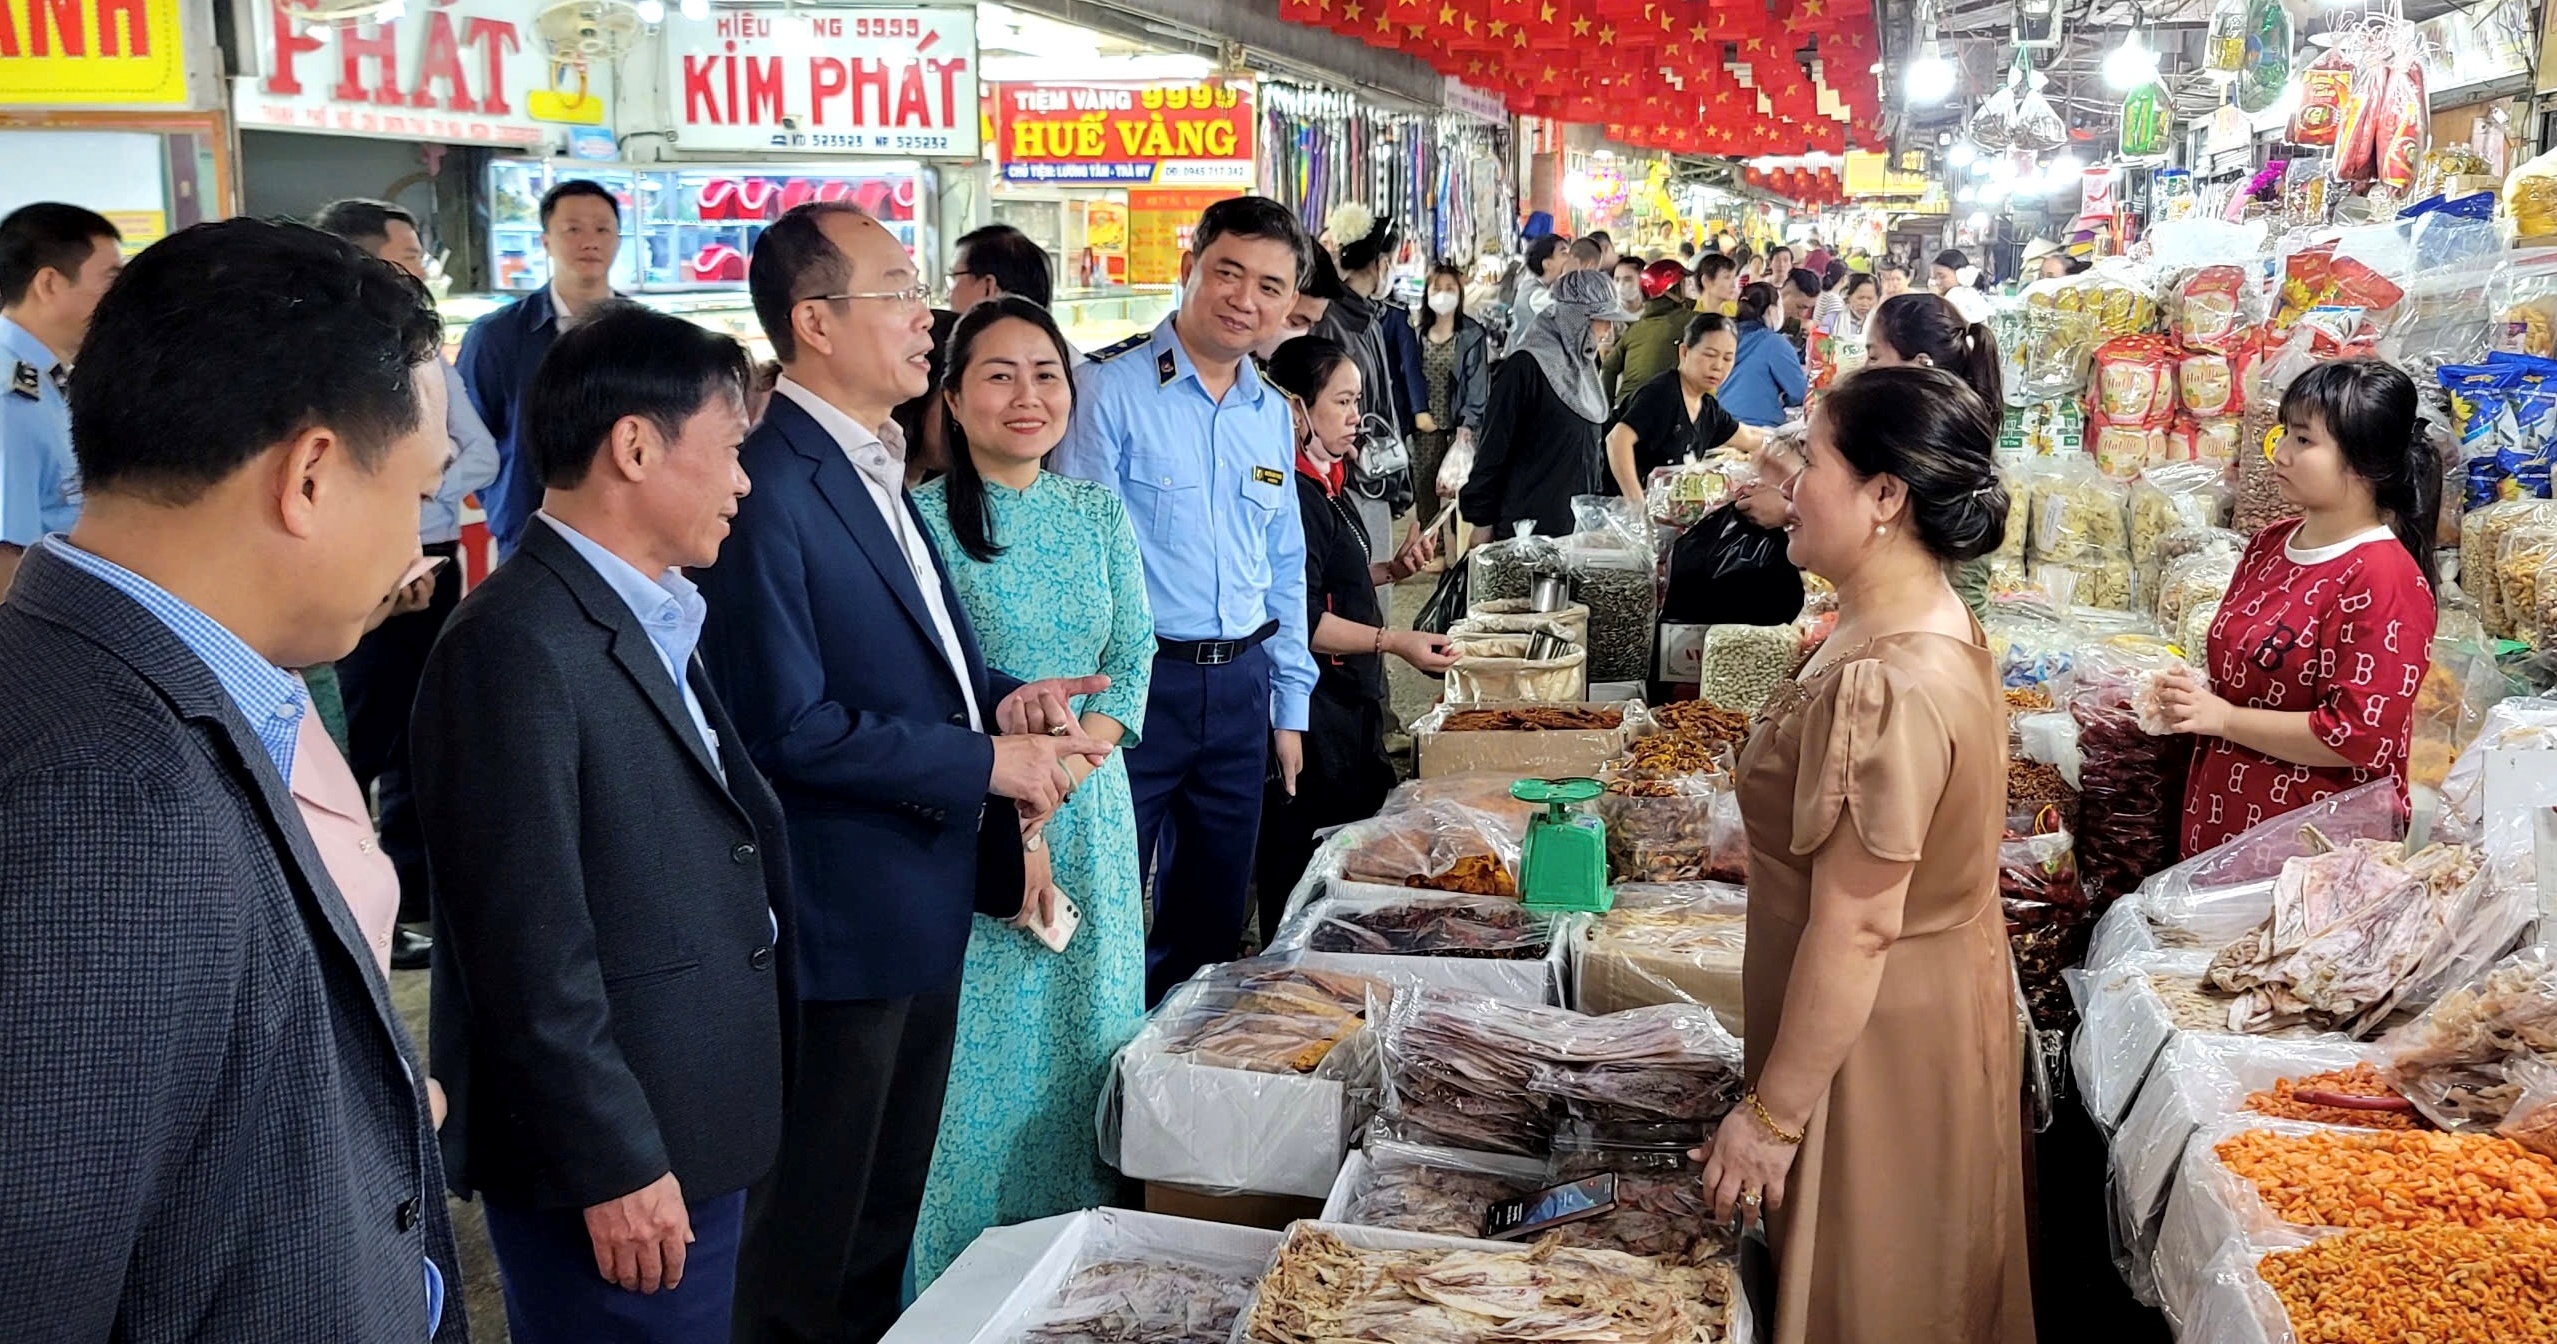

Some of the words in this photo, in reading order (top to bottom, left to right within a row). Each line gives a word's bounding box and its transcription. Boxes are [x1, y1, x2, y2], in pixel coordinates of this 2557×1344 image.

[856, 17, 920, 38] 9999
[808, 29, 967, 129] PHÁT
[1014, 88, 1068, 115] TIỆM
[1071, 87, 1132, 111] VÀNG
[1140, 82, 1238, 110] 9999
[1011, 111, 1109, 158] HUẾ
[1114, 111, 1239, 158] VÀNG
[2350, 651, 2376, 686] B
[2397, 663, 2420, 697] B
[2207, 793, 2224, 825] B
